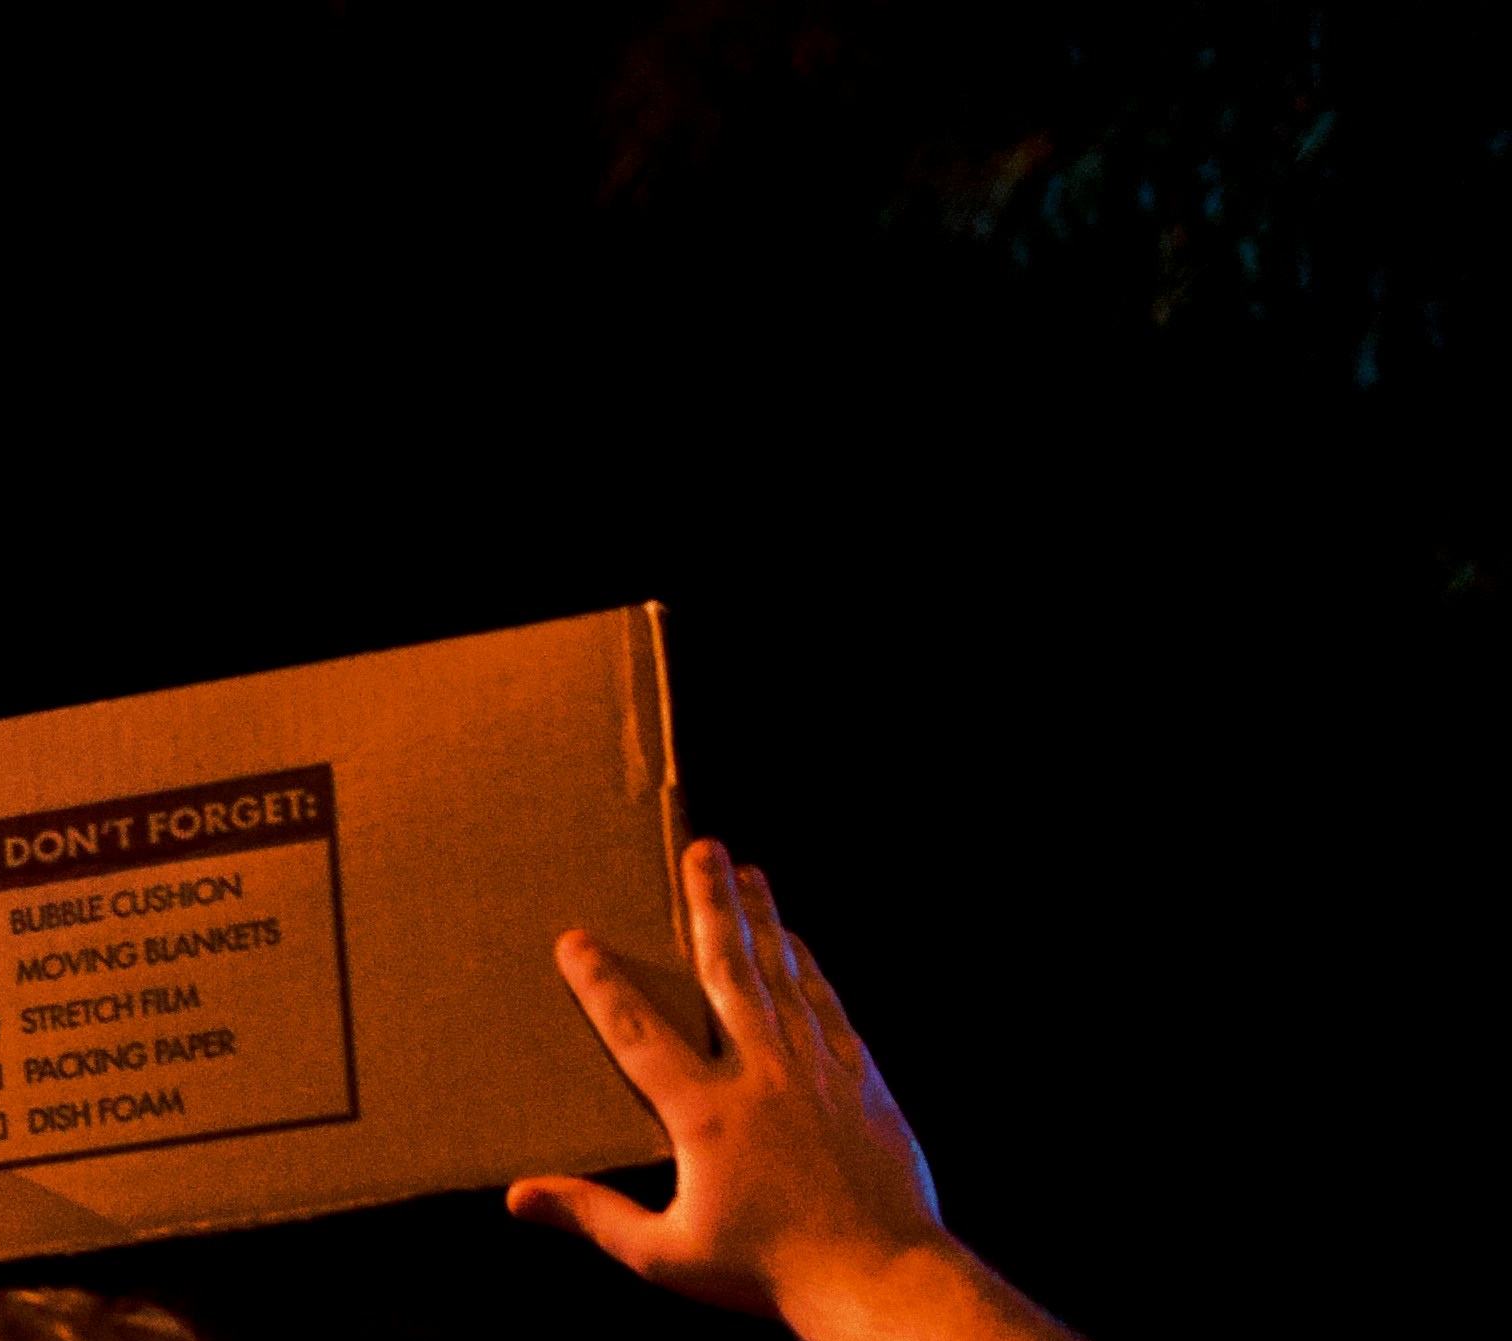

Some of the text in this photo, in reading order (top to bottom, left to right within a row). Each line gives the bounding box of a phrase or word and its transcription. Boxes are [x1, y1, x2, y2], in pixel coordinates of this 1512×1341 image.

[2, 788, 320, 868] DON'T FORGET:
[9, 872, 245, 935] BUBBLE CUSHION
[16, 916, 283, 985] MOVING BLANKETS
[19, 984, 202, 1034] STRETCH FILM
[24, 1028, 237, 1085] PACKING PAPER
[26, 1088, 186, 1135] DISH FOAM
